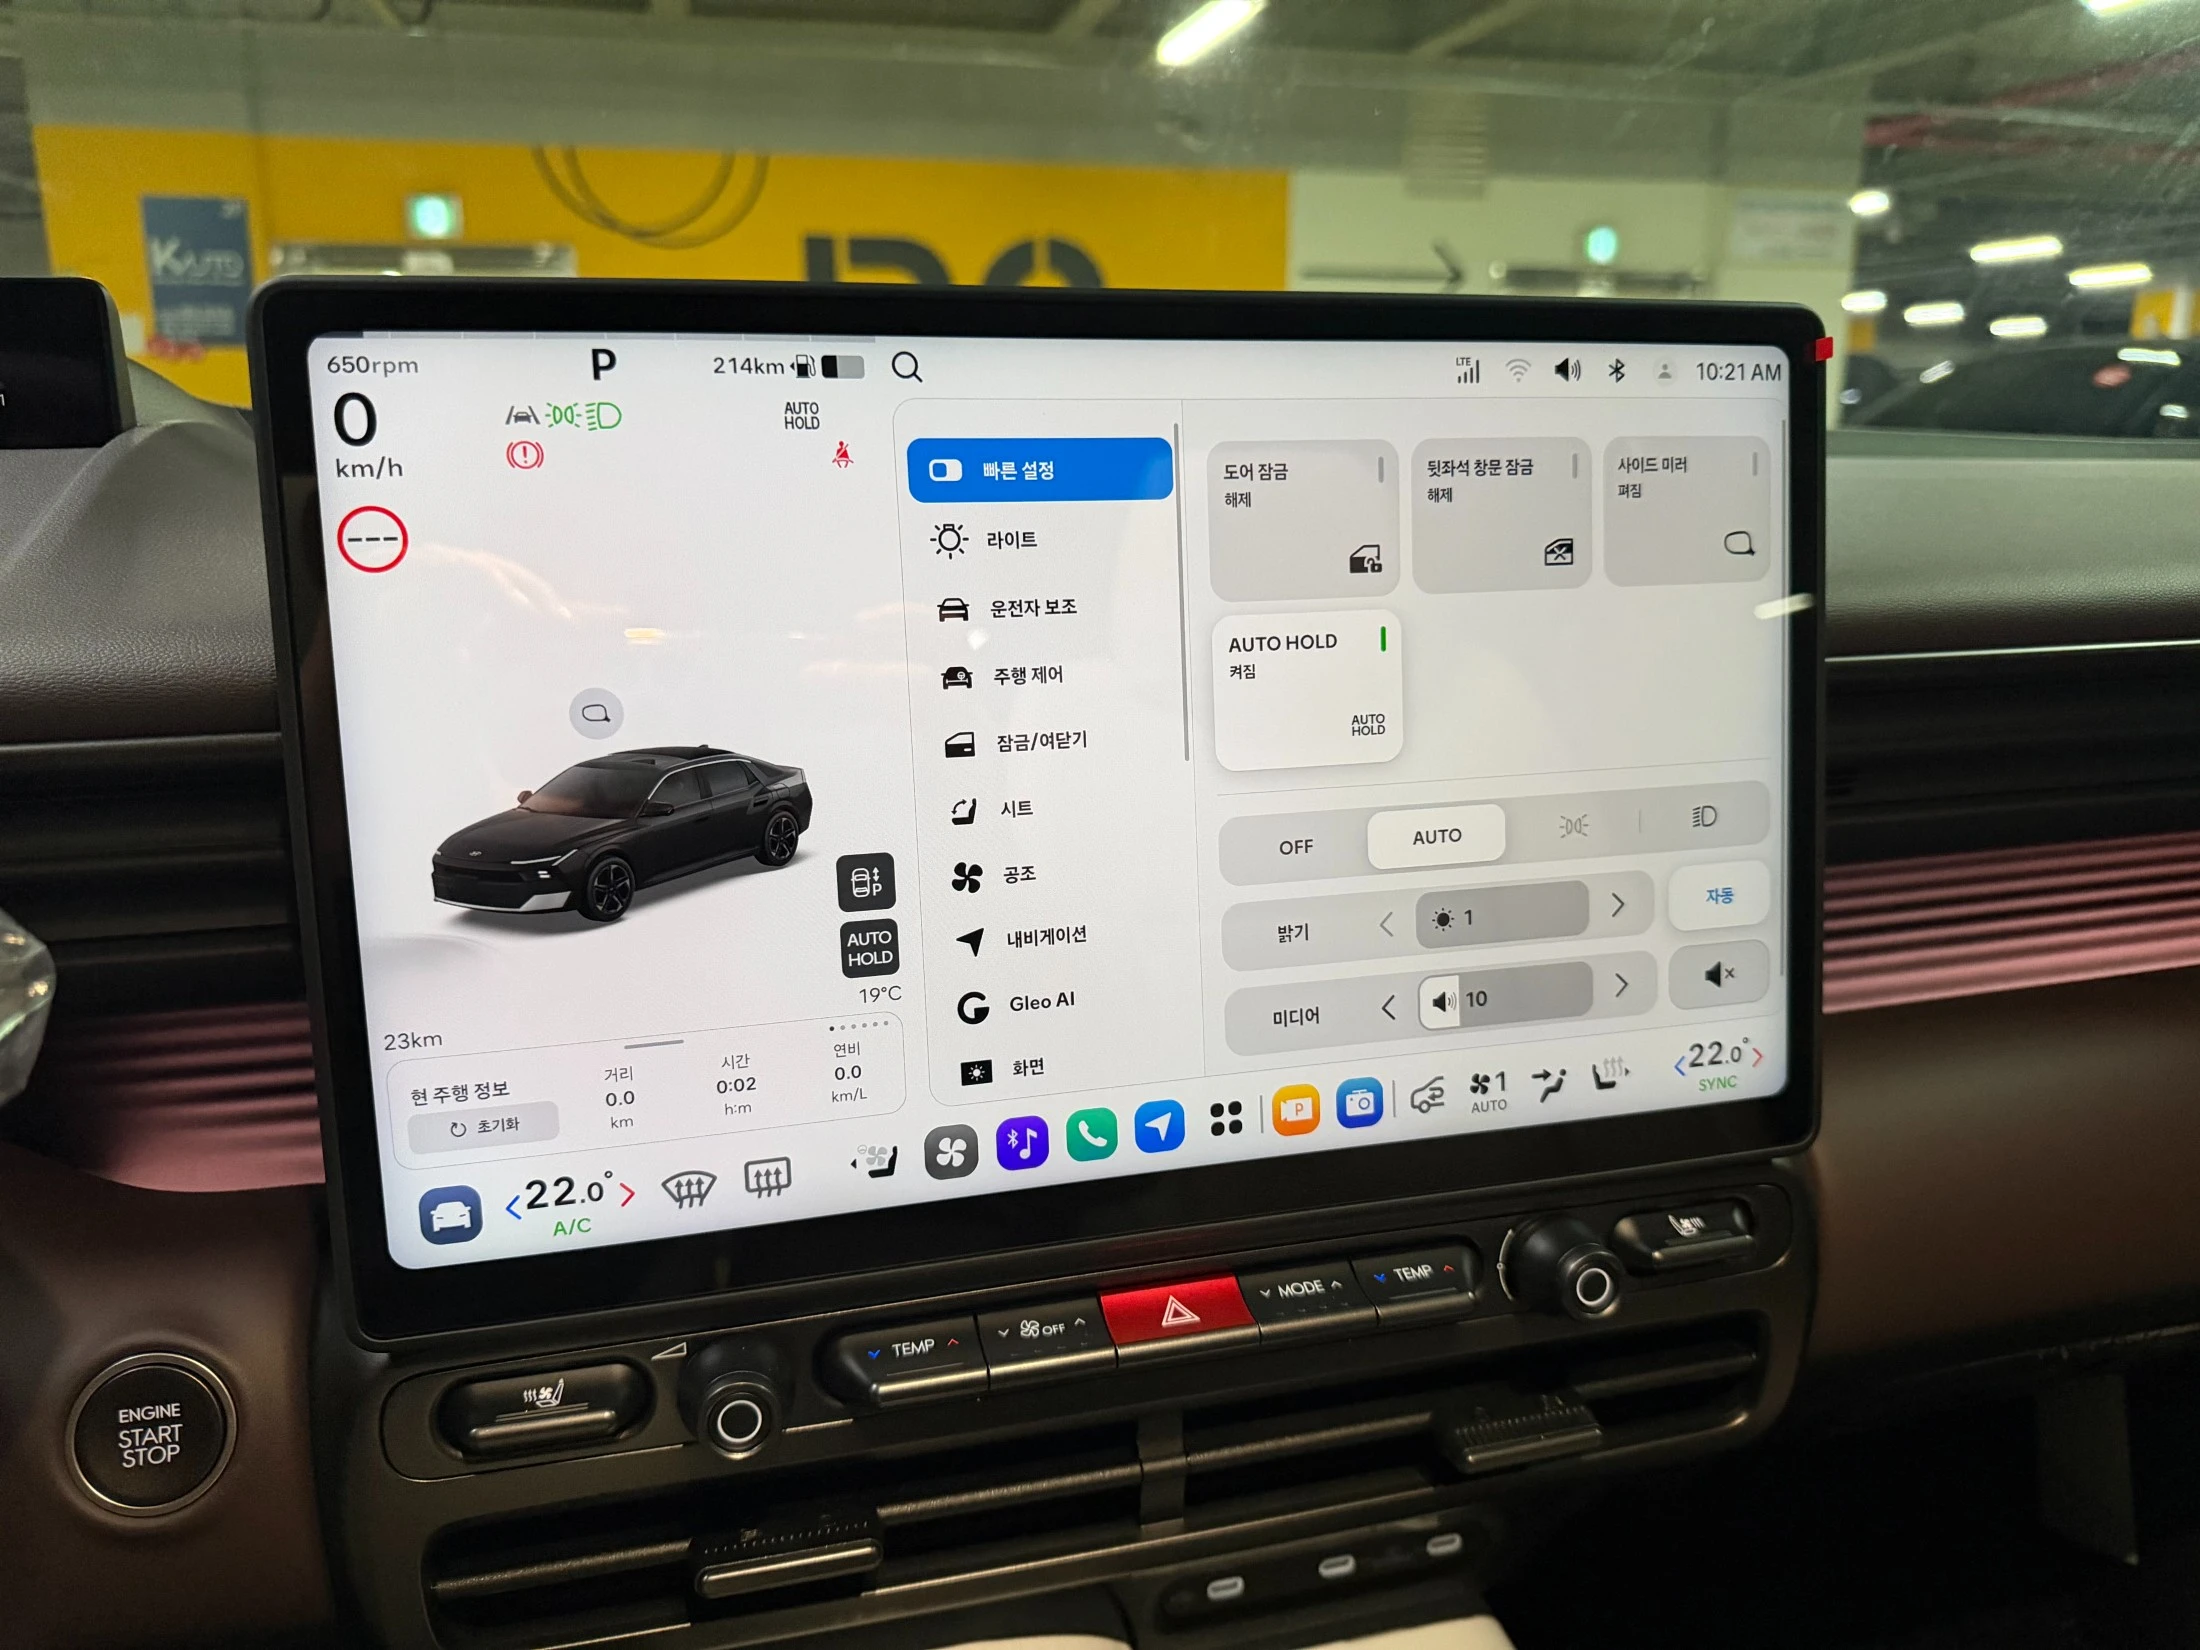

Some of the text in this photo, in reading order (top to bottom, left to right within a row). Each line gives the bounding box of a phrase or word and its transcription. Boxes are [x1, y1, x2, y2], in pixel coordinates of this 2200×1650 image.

[327, 356, 419, 378] 650rpm
[592, 348, 617, 381] P
[713, 357, 785, 374] 214km
[1456, 358, 1472, 367] LTE
[1696, 363, 1782, 382] 10:21 AM
[784, 402, 819, 415] AUTO
[334, 392, 378, 447] 0
[784, 416, 820, 430] HOLD
[336, 456, 403, 480] km/h
[983, 460, 1054, 480] 빠른 설정
[1223, 463, 1288, 481] 도어 잠금
[1427, 458, 1534, 477] 뒷좌석 창문 잠금
[1618, 456, 1688, 474] 사이드 미러
[1224, 492, 1252, 508] 해제
[1427, 487, 1453, 503] 해제
[1618, 483, 1642, 499] 펴짐
[987, 531, 1038, 550] 라이트
[990, 598, 1078, 618] 운전자 보조
[1228, 634, 1338, 652] AUTO HOLD
[994, 666, 1064, 686] 주행 제어
[1229, 664, 1256, 680] 켜짐
[1352, 714, 1386, 726] AUTO
[1352, 725, 1386, 736] HOLD
[997, 730, 1088, 752] 잠금/여닫기
[1001, 800, 1034, 818] 시트
[1412, 828, 1462, 846] AUTO
[1279, 839, 1314, 856] OFF
[1004, 866, 1036, 884] 공조
[1706, 886, 1735, 904] 자동
[1464, 910, 1473, 926] 1
[847, 930, 892, 947] AUTO
[1007, 925, 1088, 948] 내비게이션
[1278, 923, 1309, 944] 밝기
[848, 951, 894, 967] HOLD
[859, 986, 902, 1004] 19°C
[1010, 991, 1075, 1012] Gleo AI
[1466, 990, 1488, 1008] 10
[1273, 1006, 1320, 1028] 미디어
[384, 1032, 443, 1051] 23km
[834, 1042, 860, 1058] 연비
[721, 1053, 750, 1070] 시간
[1012, 1058, 1044, 1076] 화면
[604, 1066, 634, 1083] 거리
[834, 1066, 862, 1080] 0.0
[1495, 1070, 1505, 1092] 1
[716, 1076, 757, 1094] 0:02
[1698, 1075, 1738, 1091] SYNC
[411, 1081, 510, 1106] 현 주행 정보
[605, 1090, 635, 1106] 0.0
[832, 1087, 868, 1103] km/L
[724, 1103, 752, 1116] h:m
[1471, 1098, 1507, 1114] AUTO
[477, 1116, 520, 1134] 초기화
[610, 1116, 634, 1130] km
[553, 1218, 592, 1237] A/C
[1393, 1264, 1434, 1282] TEMP
[1278, 1279, 1326, 1298] MODE
[1042, 1322, 1066, 1336] OFF
[892, 1338, 935, 1358] TEMP
[118, 1402, 181, 1424] ENGINE
[118, 1424, 183, 1448] START
[122, 1444, 180, 1468] STOP
